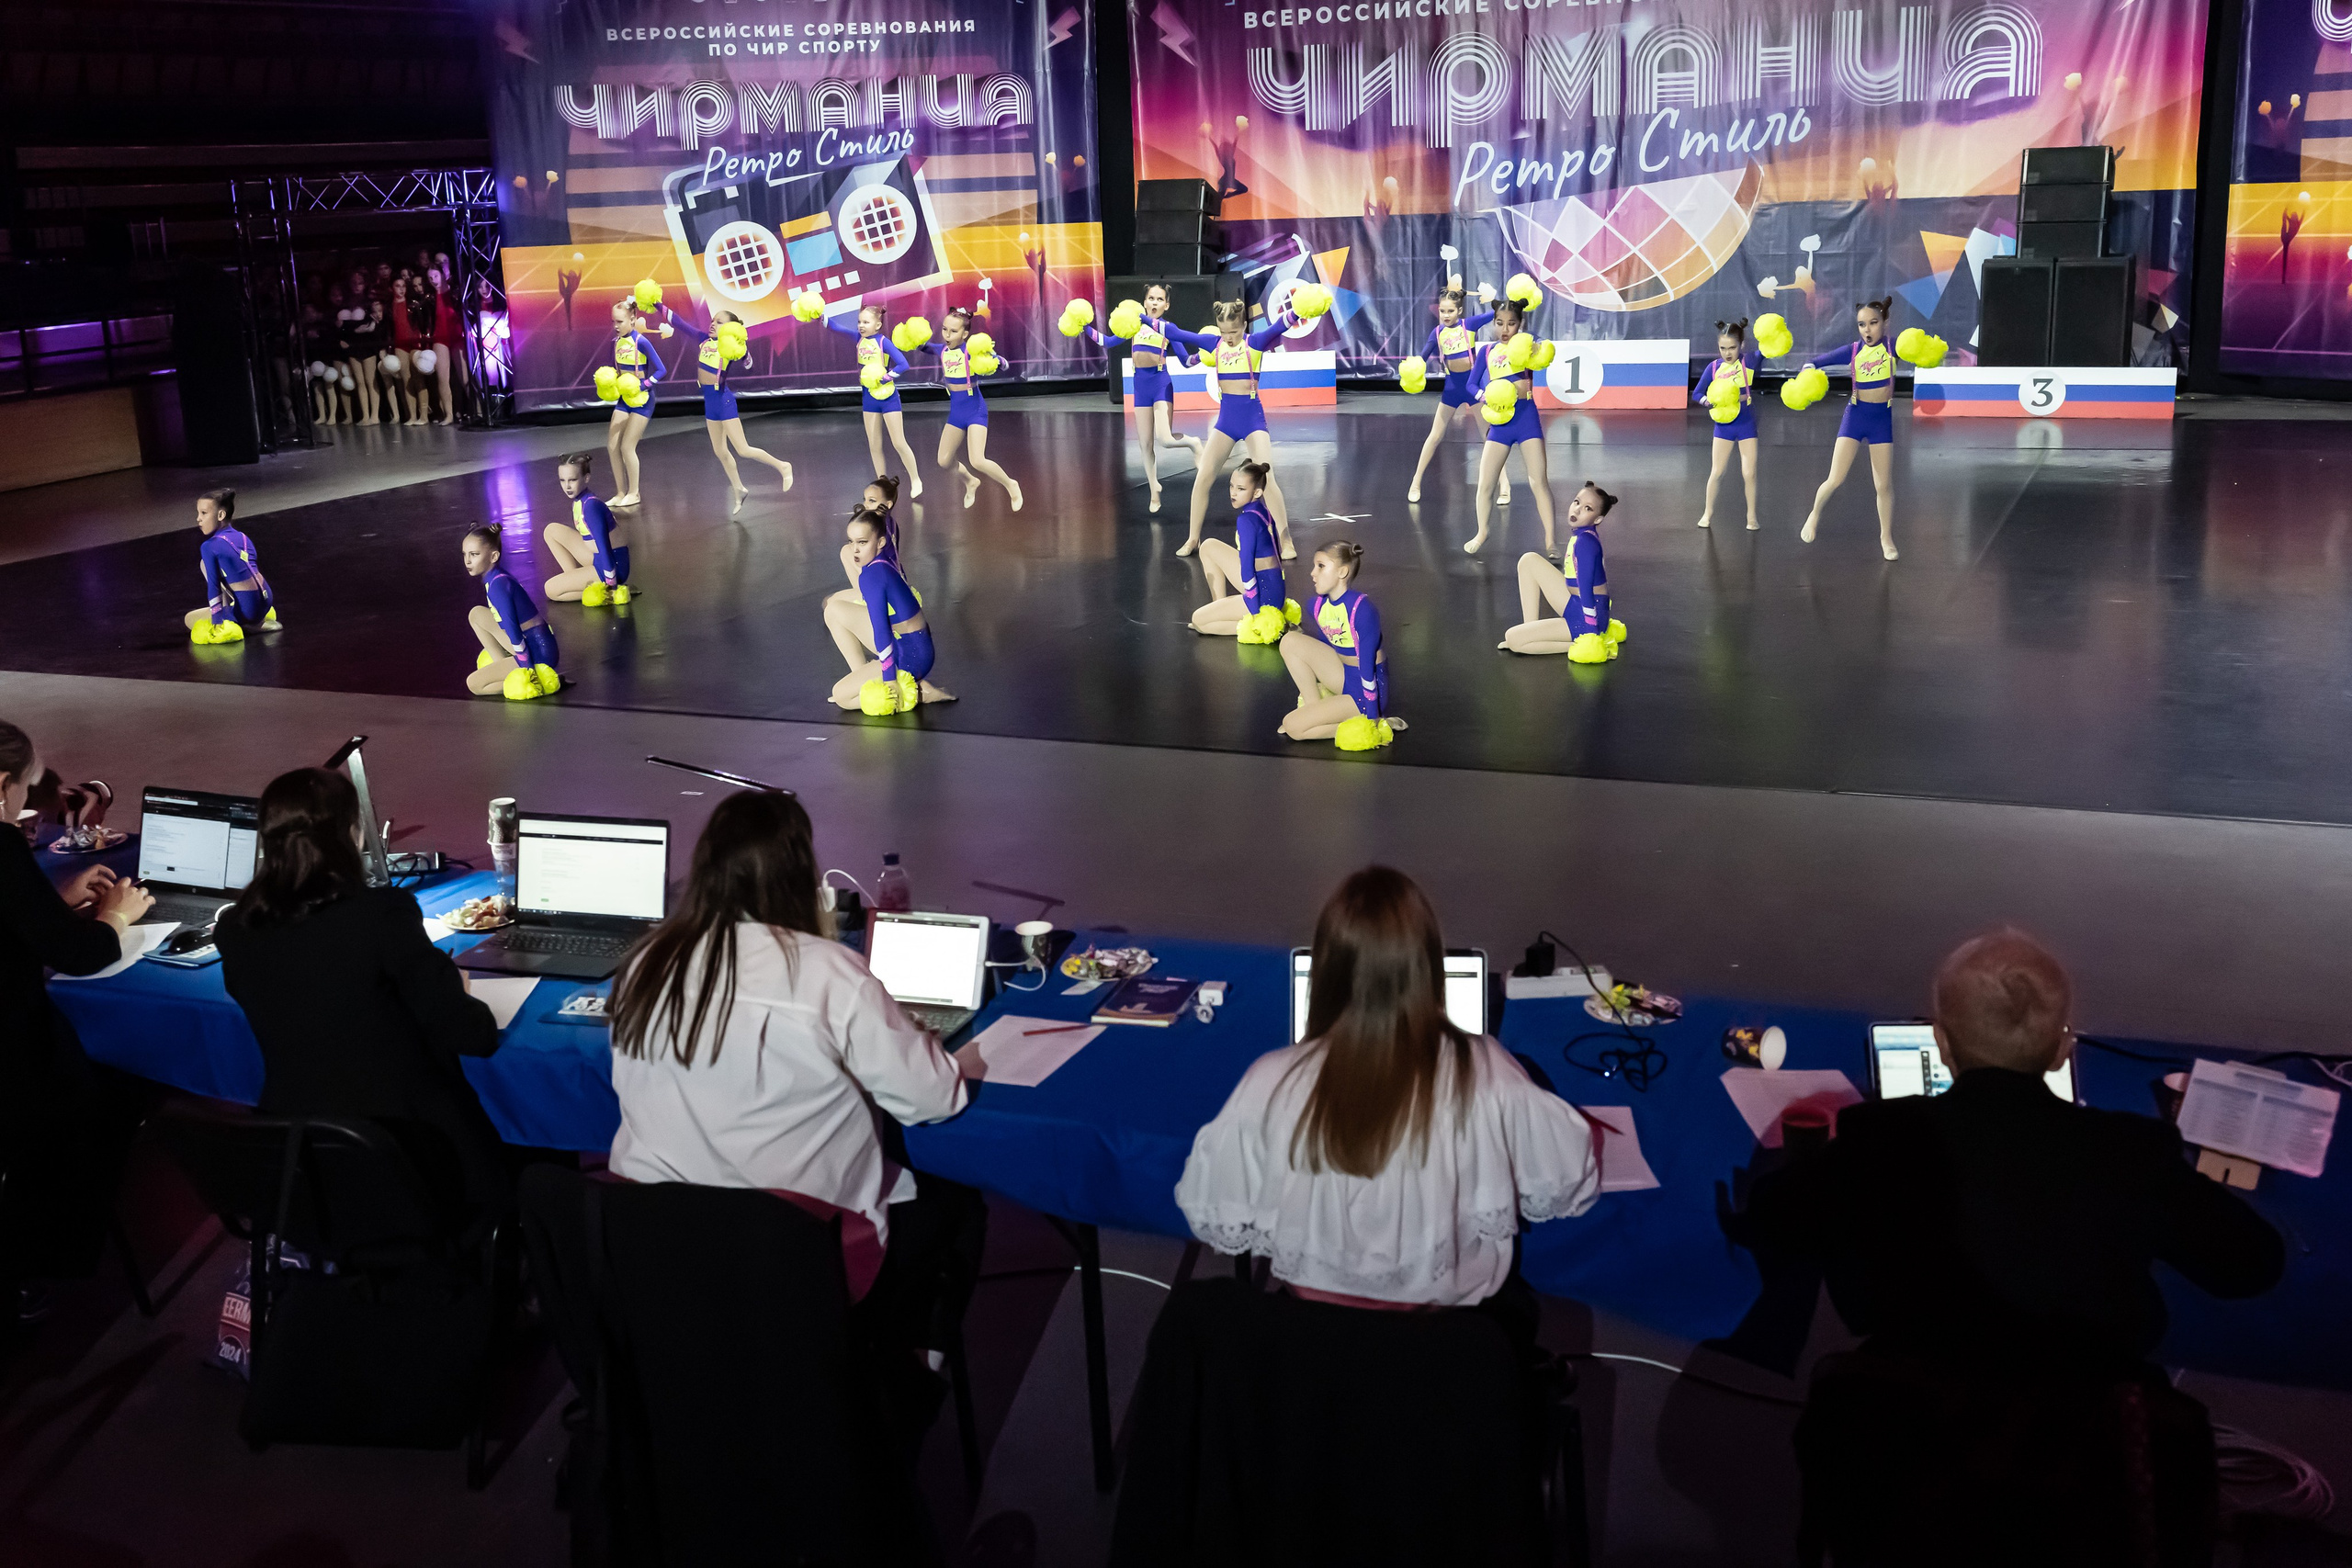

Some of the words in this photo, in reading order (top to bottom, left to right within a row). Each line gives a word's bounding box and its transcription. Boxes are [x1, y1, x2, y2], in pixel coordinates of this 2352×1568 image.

[1244, 0, 1489, 28] ВСЕРОССИЙСКИЕ
[606, 23, 794, 41] ВСЕРОССИЙСКИЕ
[804, 20, 976, 37] СОРЕВНОВАНИЯ
[708, 43, 737, 57] ПО
[747, 41, 788, 55] ЧИР
[798, 39, 881, 55] СПОРТУ
[703, 146, 802, 186] Ретро
[815, 128, 915, 165] Стиль
[1453, 141, 1615, 207] Ретро
[1639, 107, 1813, 173] Стиль
[1564, 355, 1587, 394] 1
[2030, 378, 2054, 407] 3
[219, 1341, 242, 1364] 2024
